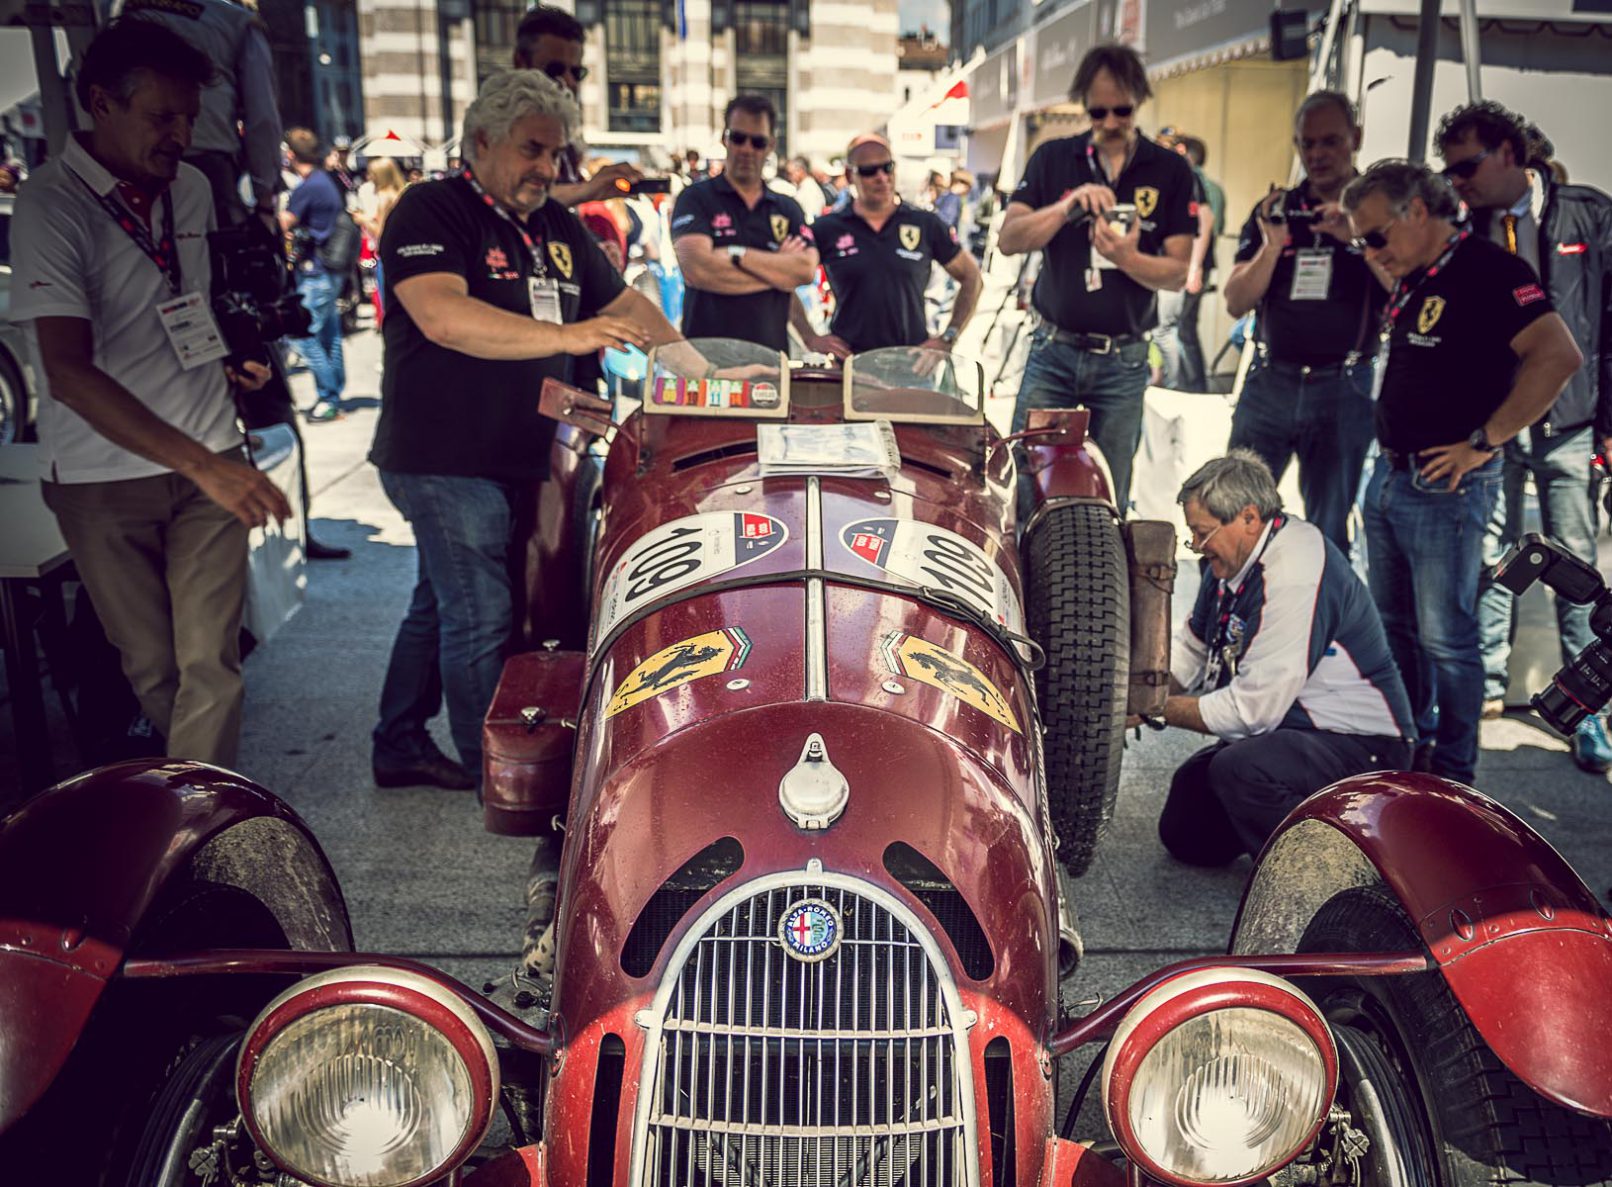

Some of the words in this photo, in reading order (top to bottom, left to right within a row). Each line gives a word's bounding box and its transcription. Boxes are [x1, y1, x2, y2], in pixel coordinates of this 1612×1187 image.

[625, 527, 703, 602] 109
[920, 534, 994, 609] 109
[793, 942, 827, 953] MILANO
